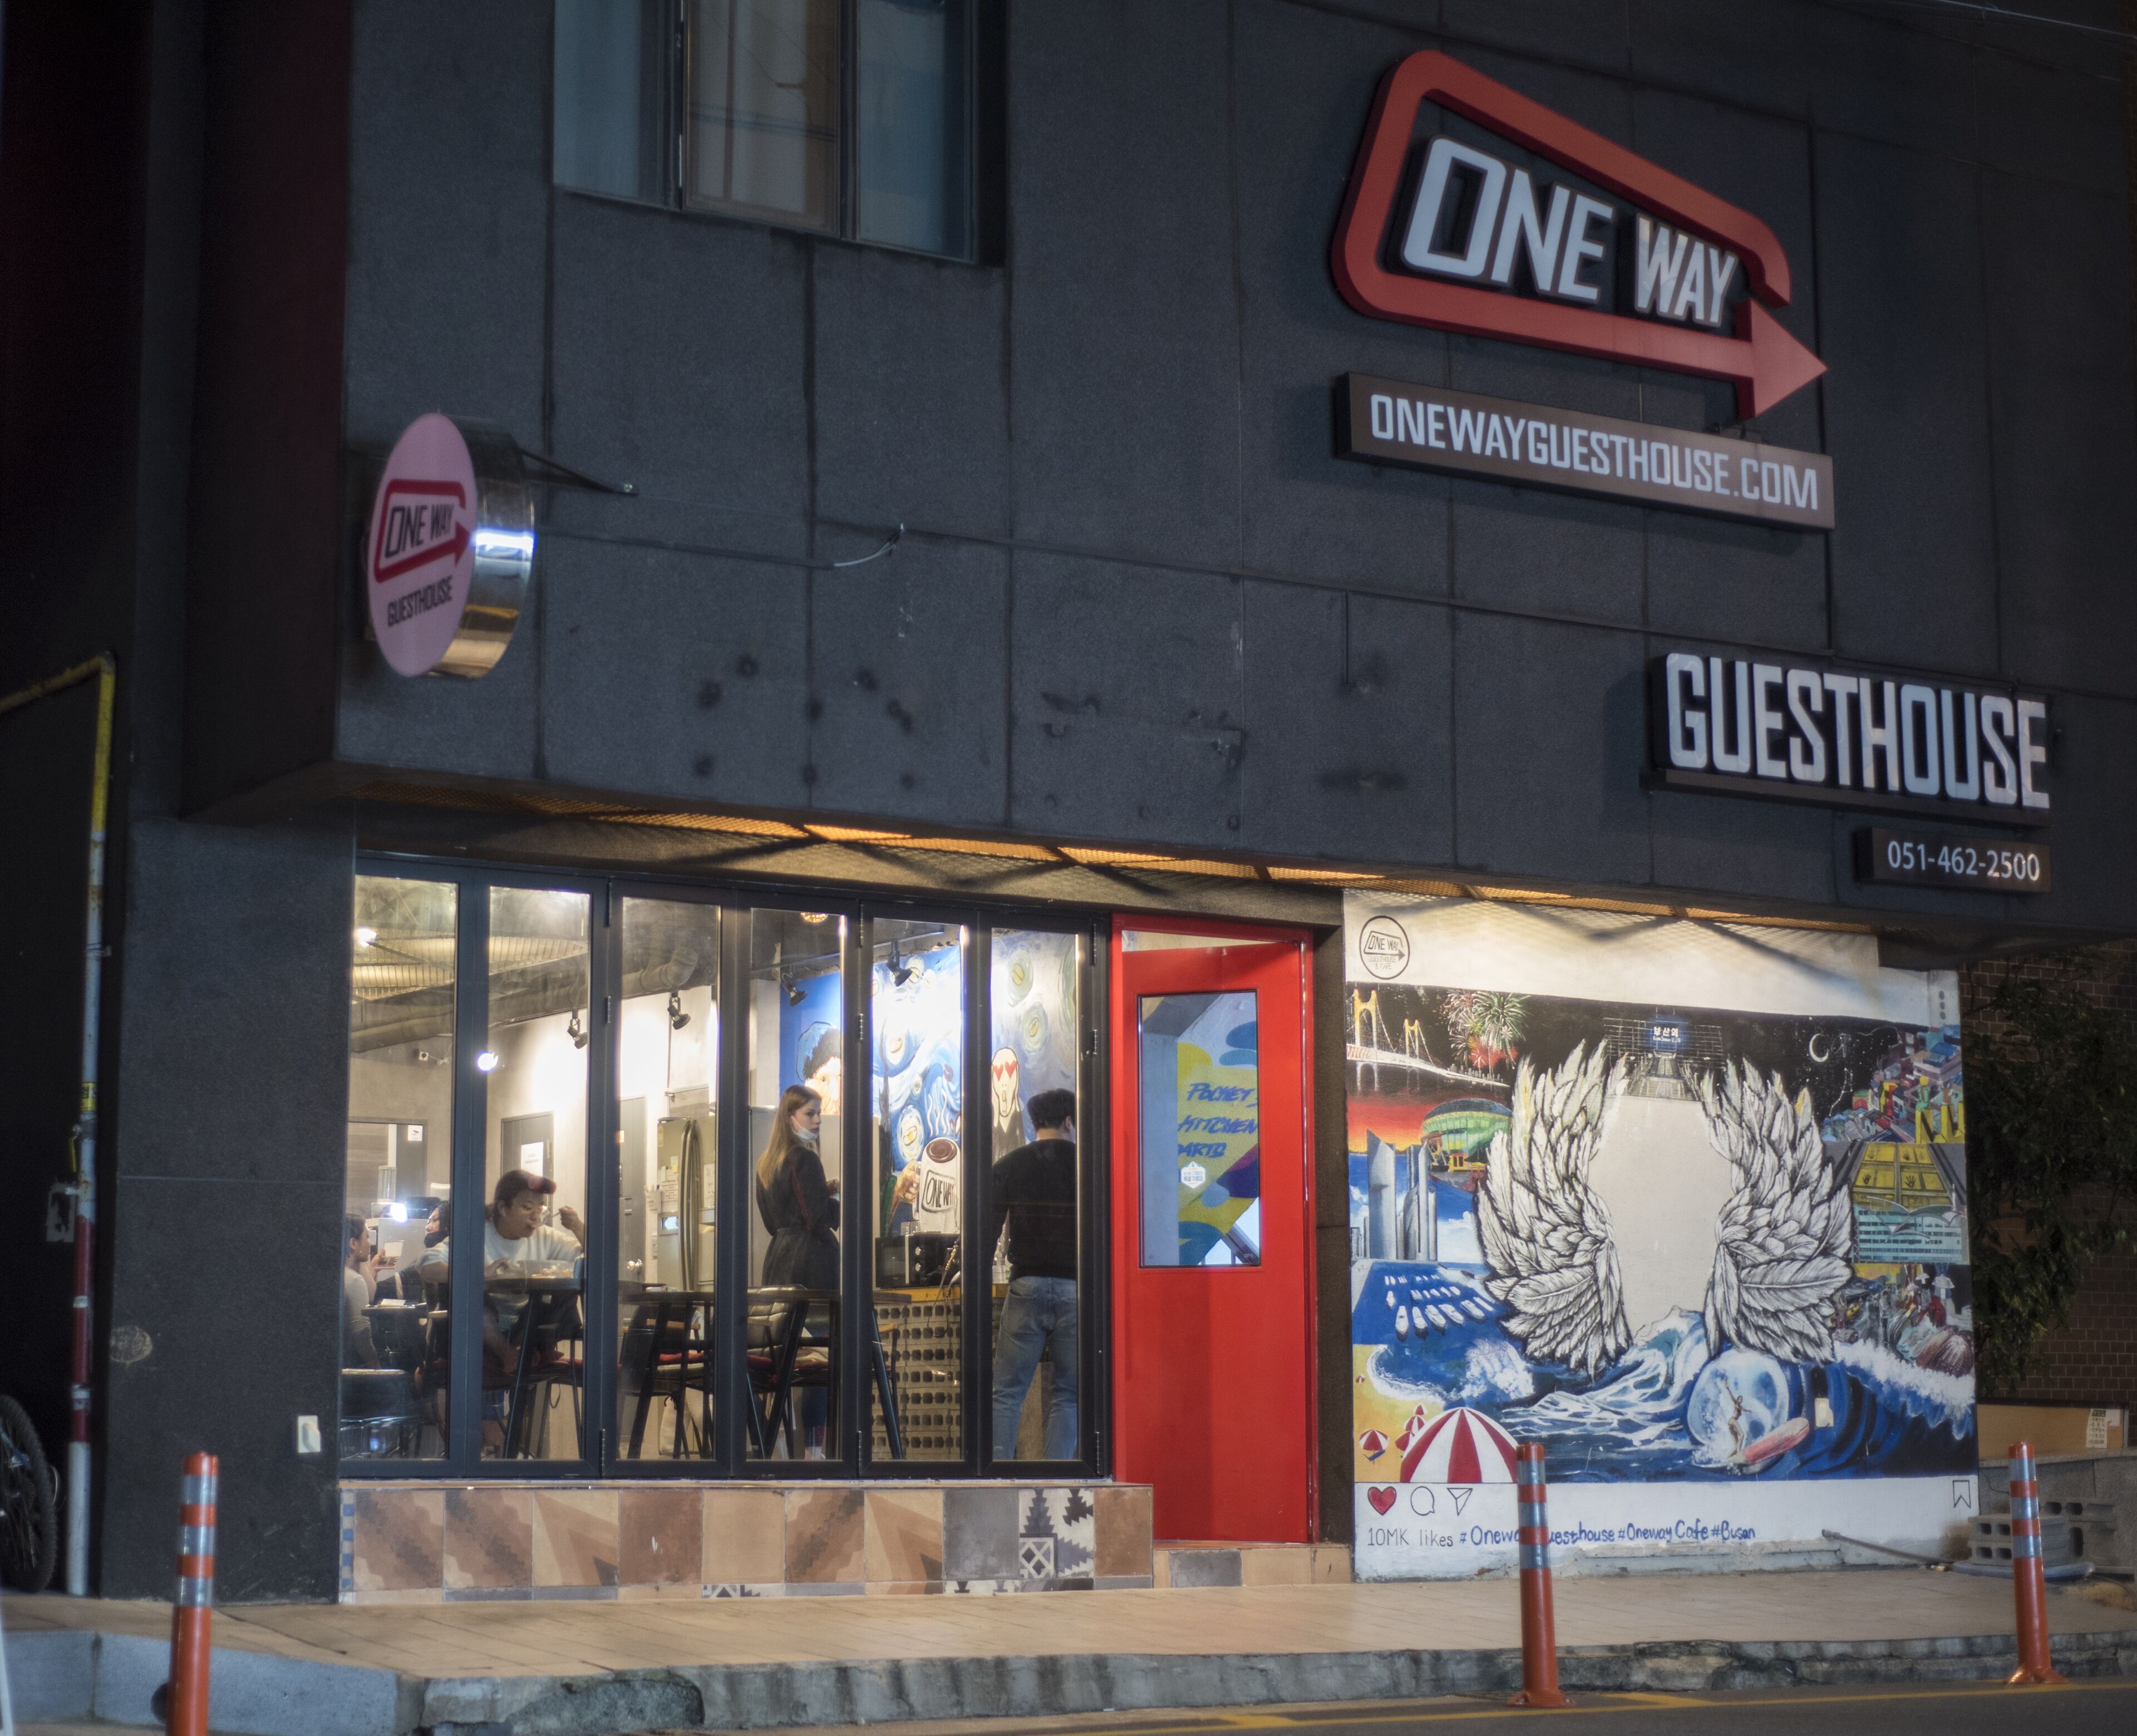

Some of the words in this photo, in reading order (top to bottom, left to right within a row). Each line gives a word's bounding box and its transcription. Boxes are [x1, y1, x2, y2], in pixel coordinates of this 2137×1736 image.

[1402, 138, 1614, 301] ONE
[1634, 217, 1737, 324] WAY
[1371, 394, 1818, 510] ONEWAYGUESTHOUSE.COM
[385, 505, 427, 558] ONE
[431, 503, 453, 539] WAY
[387, 575, 452, 627] GUESTHOUSE
[1666, 653, 2050, 809] GUESTHOUSE
[1888, 840, 2040, 881] 051-462-2500
[1368, 935, 1385, 950] ONE
[1387, 939, 1399, 951] WAY
[926, 1177, 942, 1208] ONE
[943, 1181, 956, 1206] WAY
[1367, 1528, 1408, 1546] 10MK
[1420, 1529, 1453, 1547] likes
